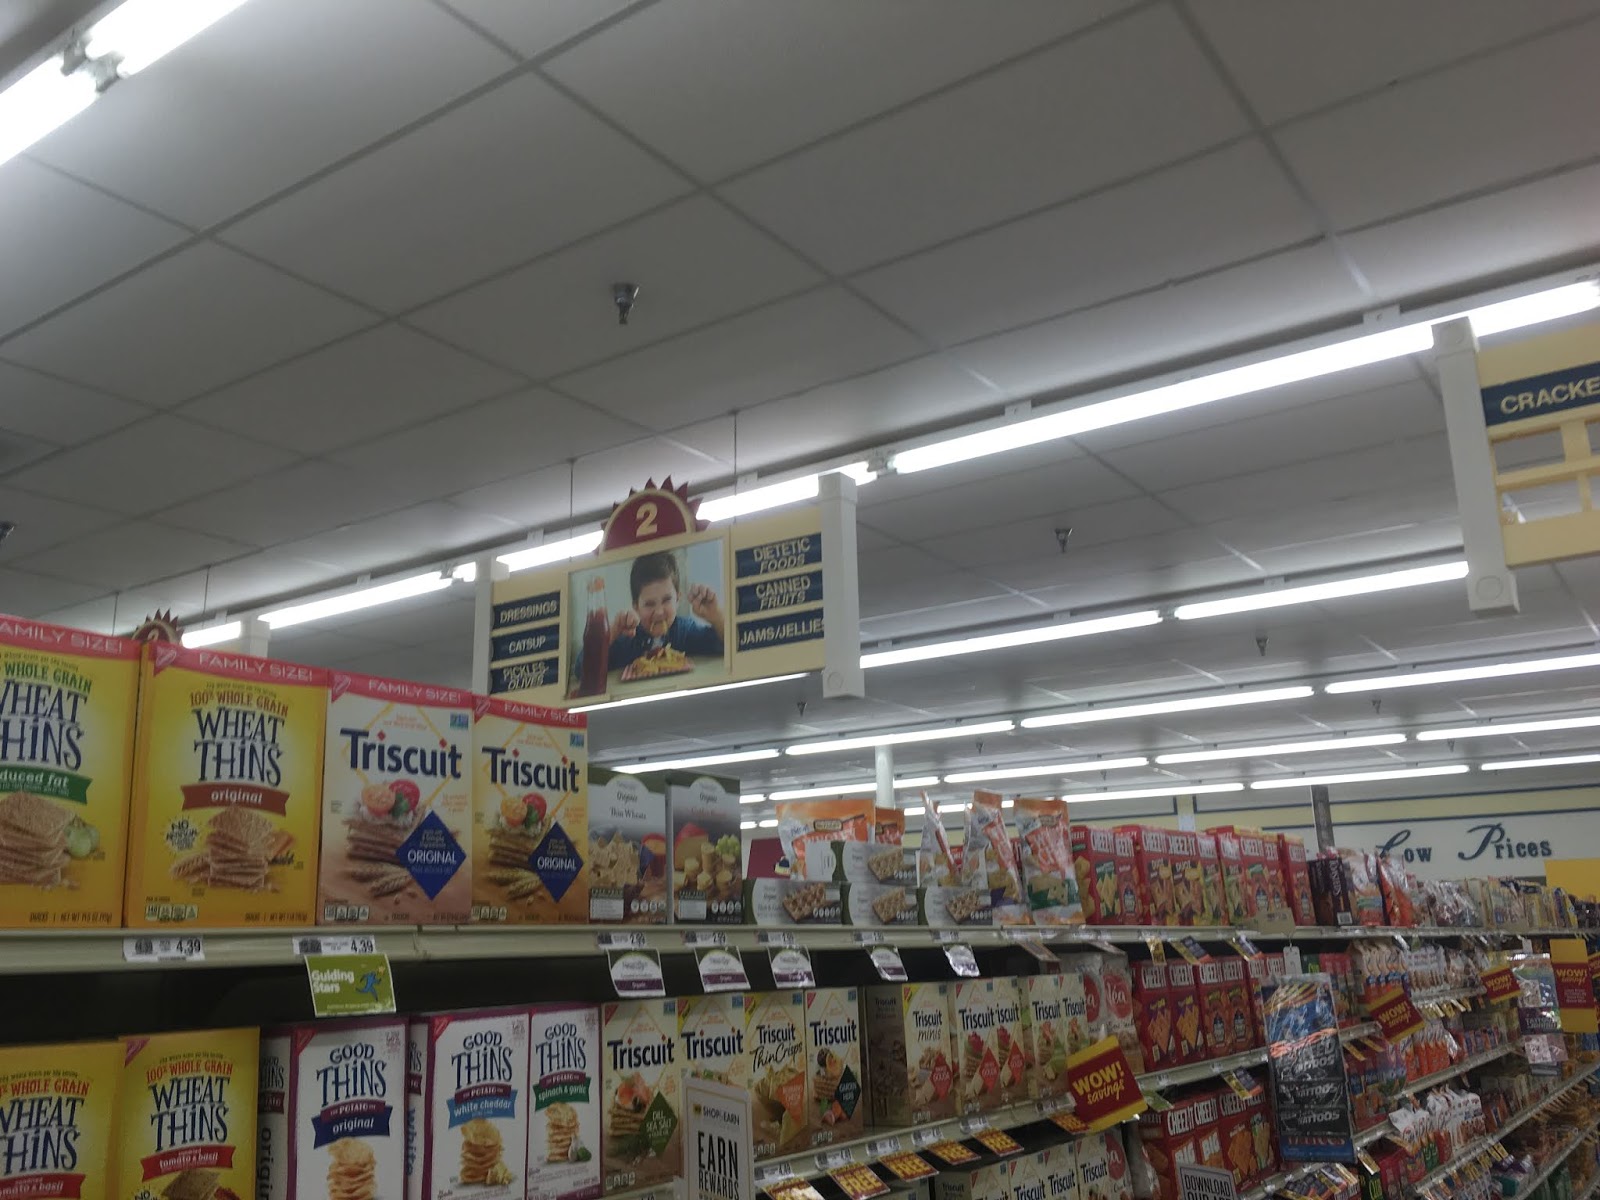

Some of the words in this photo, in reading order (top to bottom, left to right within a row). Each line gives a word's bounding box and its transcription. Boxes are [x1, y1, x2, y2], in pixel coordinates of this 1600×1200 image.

[1500, 376, 1600, 416] CRACKE
[635, 503, 658, 537] 2
[753, 537, 811, 562] DIETETIC
[760, 554, 806, 574] FOODS
[756, 575, 811, 599] CANNED
[760, 591, 806, 610] FRUITS
[500, 600, 557, 624] DRESSINGS
[71, 632, 122, 654] SIZE!
[508, 635, 546, 654] CATSUP
[200, 652, 265, 675] FAMILY
[269, 663, 313, 682] SIZE!
[4, 662, 48, 681] WHOLE
[53, 668, 93, 695] GRAIN
[507, 673, 545, 690] OLIVES
[368, 679, 422, 698] FAMILY
[425, 689, 461, 704] SIZE!
[190, 690, 214, 707] 100%
[217, 690, 253, 707] WHOLE
[256, 696, 289, 718] GRAIN
[504, 703, 548, 718] FAMILY
[550, 709, 579, 723] SIZE!
[191, 706, 285, 749] WHEAT
[340, 727, 463, 780] Triscuit
[481, 745, 580, 794] Triscuit
[47, 774, 69, 788] fat
[211, 789, 263, 805] original
[1375, 829, 1433, 863] Low
[1458, 822, 1553, 861] Prices
[407, 849, 457, 865] ORIGINAL
[537, 856, 577, 870] ORIGINAL
[176, 938, 201, 955] 4.39
[351, 939, 374, 953] 4.39
[311, 969, 355, 984] Guiding
[1485, 974, 1511, 990] WOW!
[1556, 968, 1587, 978] WOW!
[312, 981, 341, 994] Stars
[995, 1002, 1020, 1024] iscuit
[1032, 999, 1061, 1021] Triscuit
[1062, 996, 1086, 1017] Triscuit
[1378, 1001, 1410, 1024] WOW!
[913, 1008, 943, 1028] Triscuit
[958, 1006, 995, 1031] Triscuit
[463, 1030, 503, 1050] GOOD
[544, 1021, 577, 1040] GOOD
[756, 1021, 796, 1045] Triscuit
[809, 1017, 857, 1047] Triscuit
[917, 1028, 942, 1042] minis
[329, 1042, 375, 1064] GOOD
[607, 1034, 675, 1070] Triscuit
[681, 1027, 744, 1061] Triscuit
[146, 1064, 167, 1083] 100%
[169, 1059, 201, 1076] WHOLE
[204, 1060, 234, 1077] GRAIN
[1072, 1060, 1125, 1096] WOW!
[11, 1078, 51, 1097] WHOLE
[54, 1078, 90, 1097] GRAIN
[147, 1075, 231, 1113] WHEAT
[538, 1084, 565, 1101] spinach
[569, 1083, 587, 1096] garlic
[1087, 1078, 1125, 1105] savings
[339, 1103, 368, 1115] POTATO
[453, 1101, 479, 1117] white
[480, 1098, 511, 1110] cheddar
[703, 1105, 720, 1118] SHOP
[722, 1113, 740, 1126] EARN
[332, 1117, 375, 1134] original
[159, 1154, 191, 1168] tomato
[198, 1152, 219, 1161] basil
[698, 1130, 739, 1180] EARN
[1048, 1168, 1076, 1196] Triscuit
[1080, 1158, 1108, 1184] Triscuit
[38, 1181, 64, 1192] basil
[698, 1168, 740, 1200] REWARDS
[1014, 1178, 1046, 1200] Triscuit
[1184, 1174, 1231, 1197] DOWNLOAD
